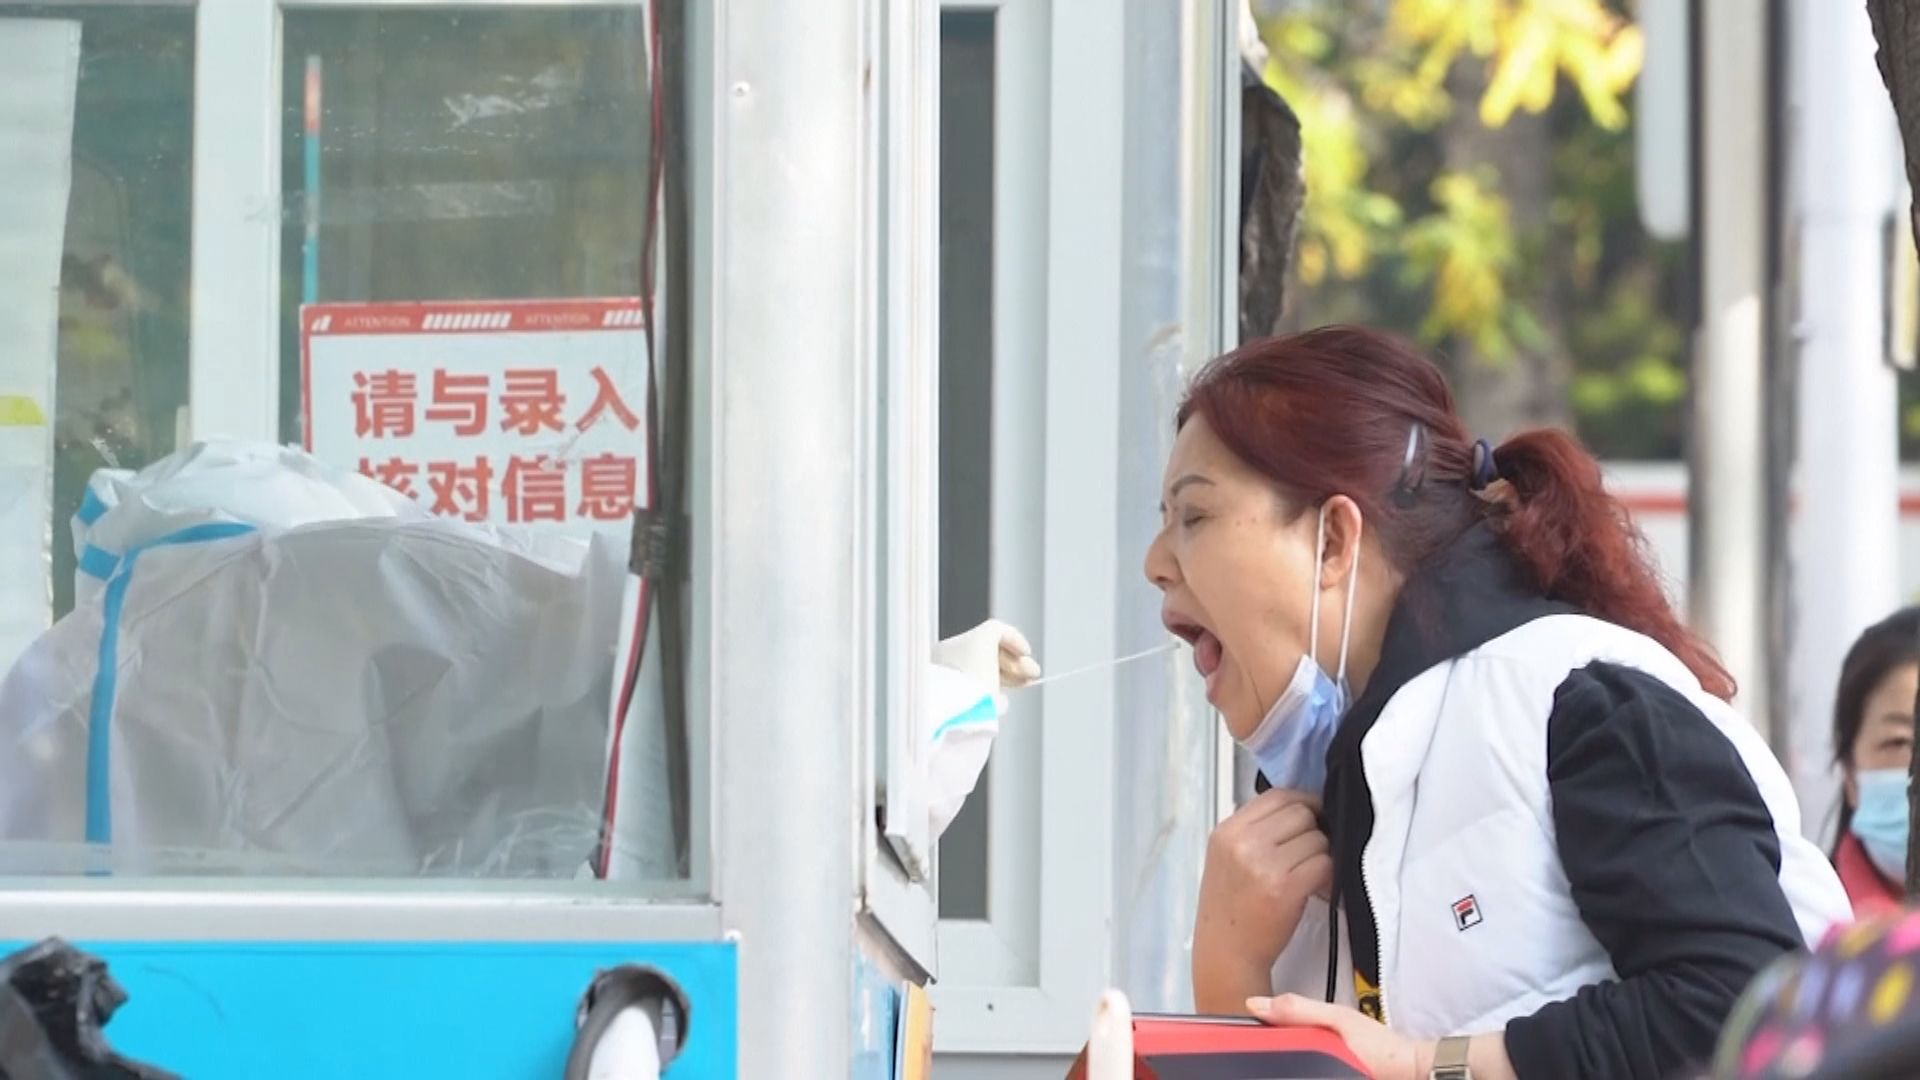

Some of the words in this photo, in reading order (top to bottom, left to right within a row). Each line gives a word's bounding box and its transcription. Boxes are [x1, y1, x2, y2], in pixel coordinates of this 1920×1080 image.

[344, 315, 411, 329] ATTENTION
[525, 312, 591, 326] ATTENTION
[351, 365, 640, 438] 请与录入
